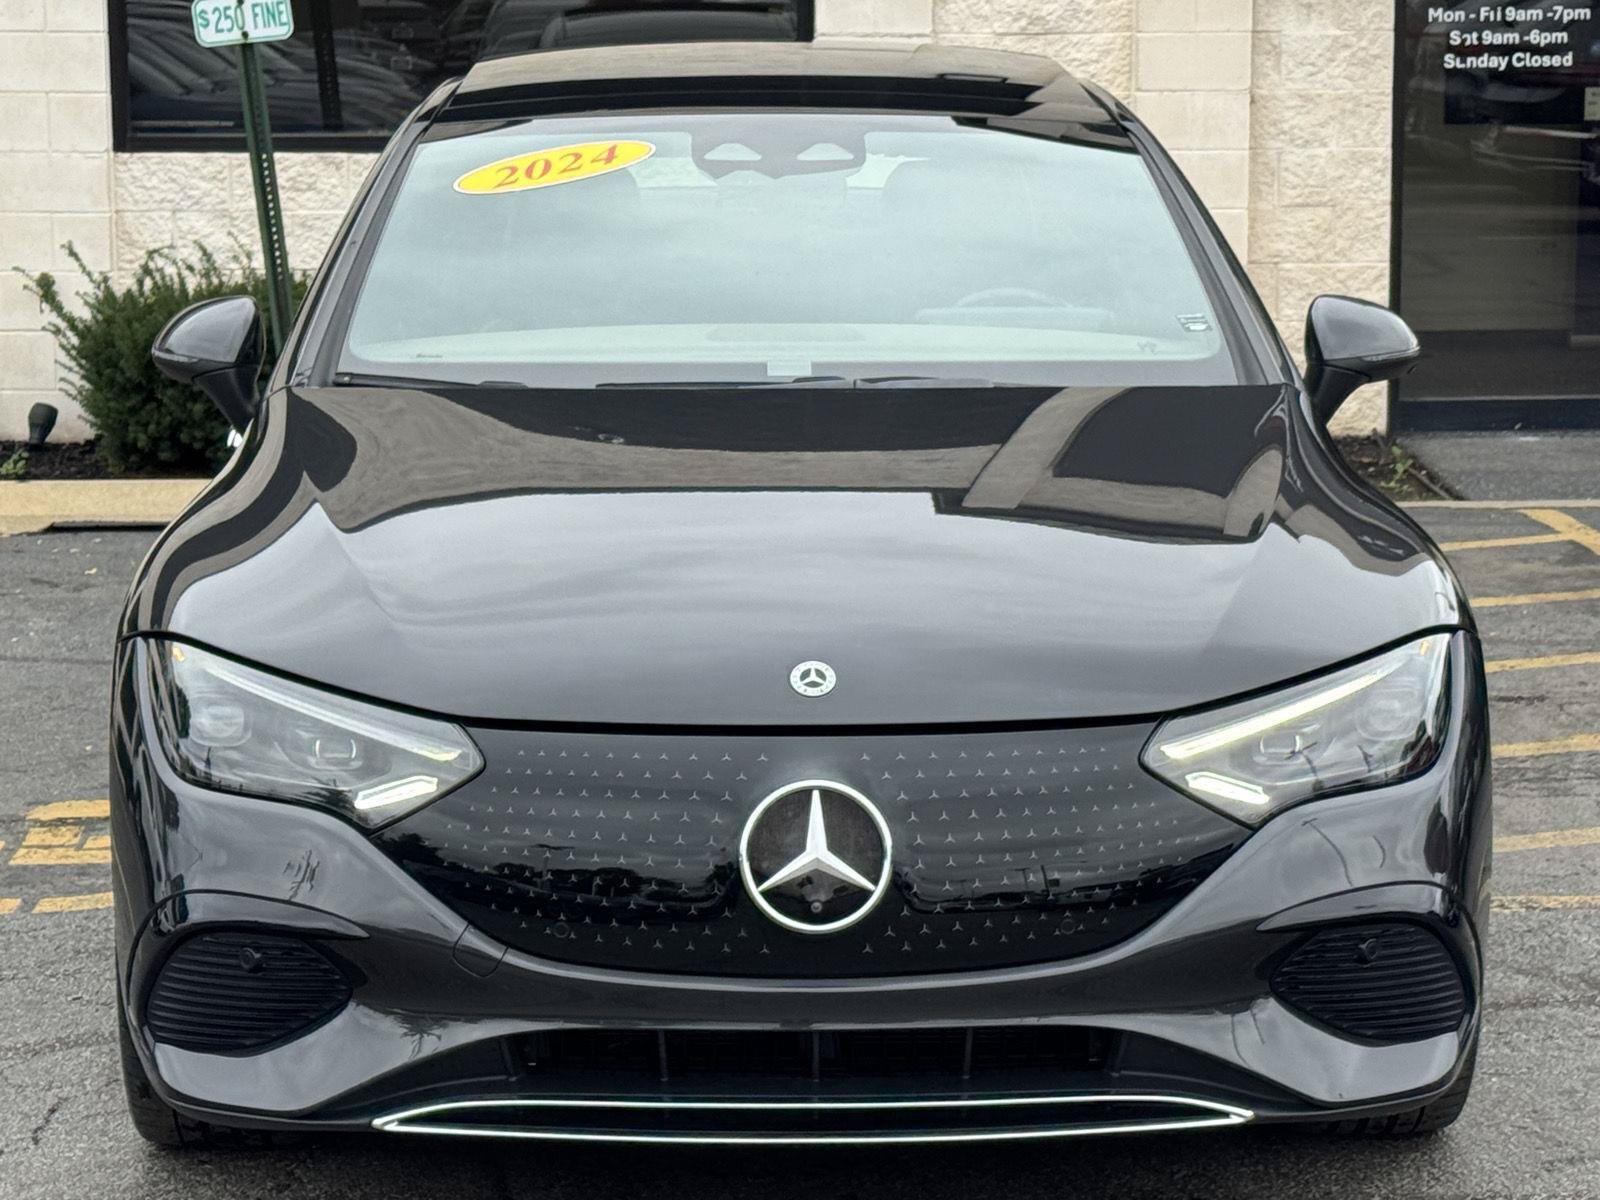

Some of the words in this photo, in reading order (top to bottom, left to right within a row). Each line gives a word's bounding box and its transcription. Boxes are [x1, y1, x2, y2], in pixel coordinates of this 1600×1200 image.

[251, 1, 288, 29] FINE
[1428, 7, 1465, 22] Mon
[1505, 6, 1543, 21] 9am
[1482, 30, 1520, 45] 9am
[1512, 52, 1573, 68] Closed
[493, 143, 618, 189] 2024
